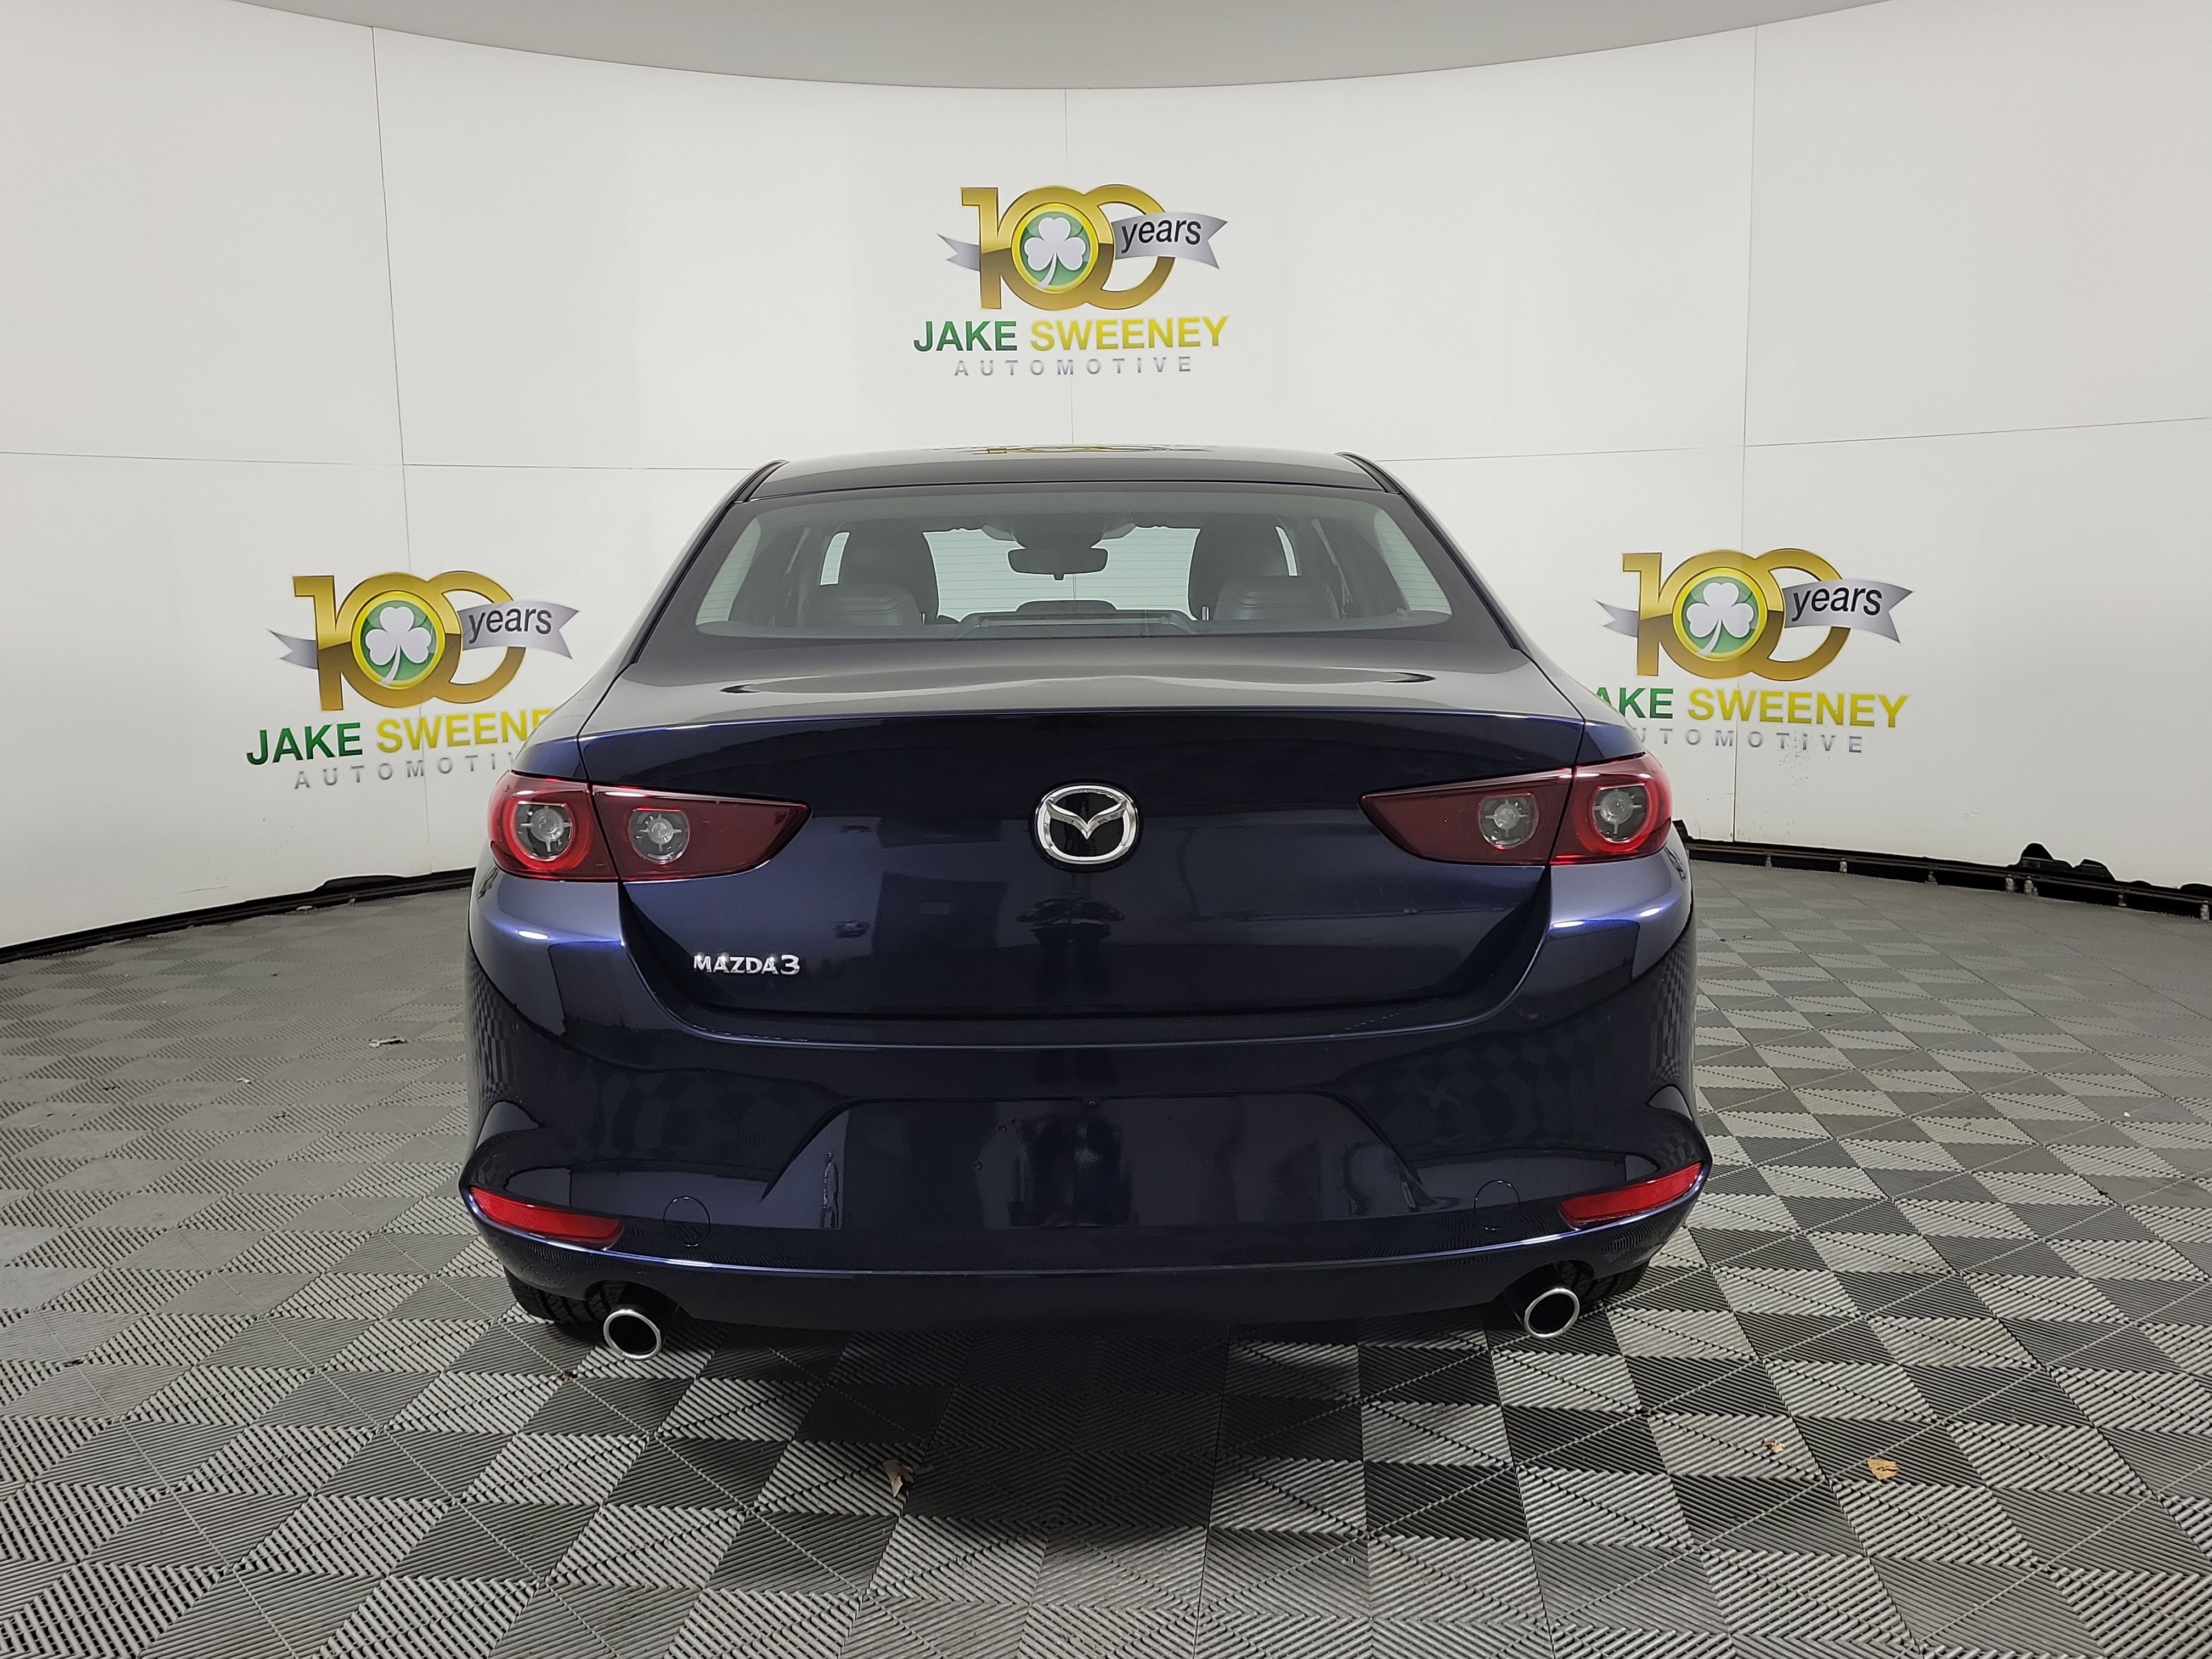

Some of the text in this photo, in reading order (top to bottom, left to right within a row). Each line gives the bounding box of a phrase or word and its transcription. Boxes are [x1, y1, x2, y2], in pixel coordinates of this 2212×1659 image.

[1121, 219, 1201, 253] years
[913, 315, 1229, 352] JAKE SWEENEY
[954, 357, 1191, 376] AUTOMOTIVE
[1792, 586, 1882, 622] years
[468, 606, 552, 644] years
[1688, 687, 1909, 728] SWEENEY
[246, 722, 363, 765] JAKE
[294, 752, 514, 789] AUTOMOTI
